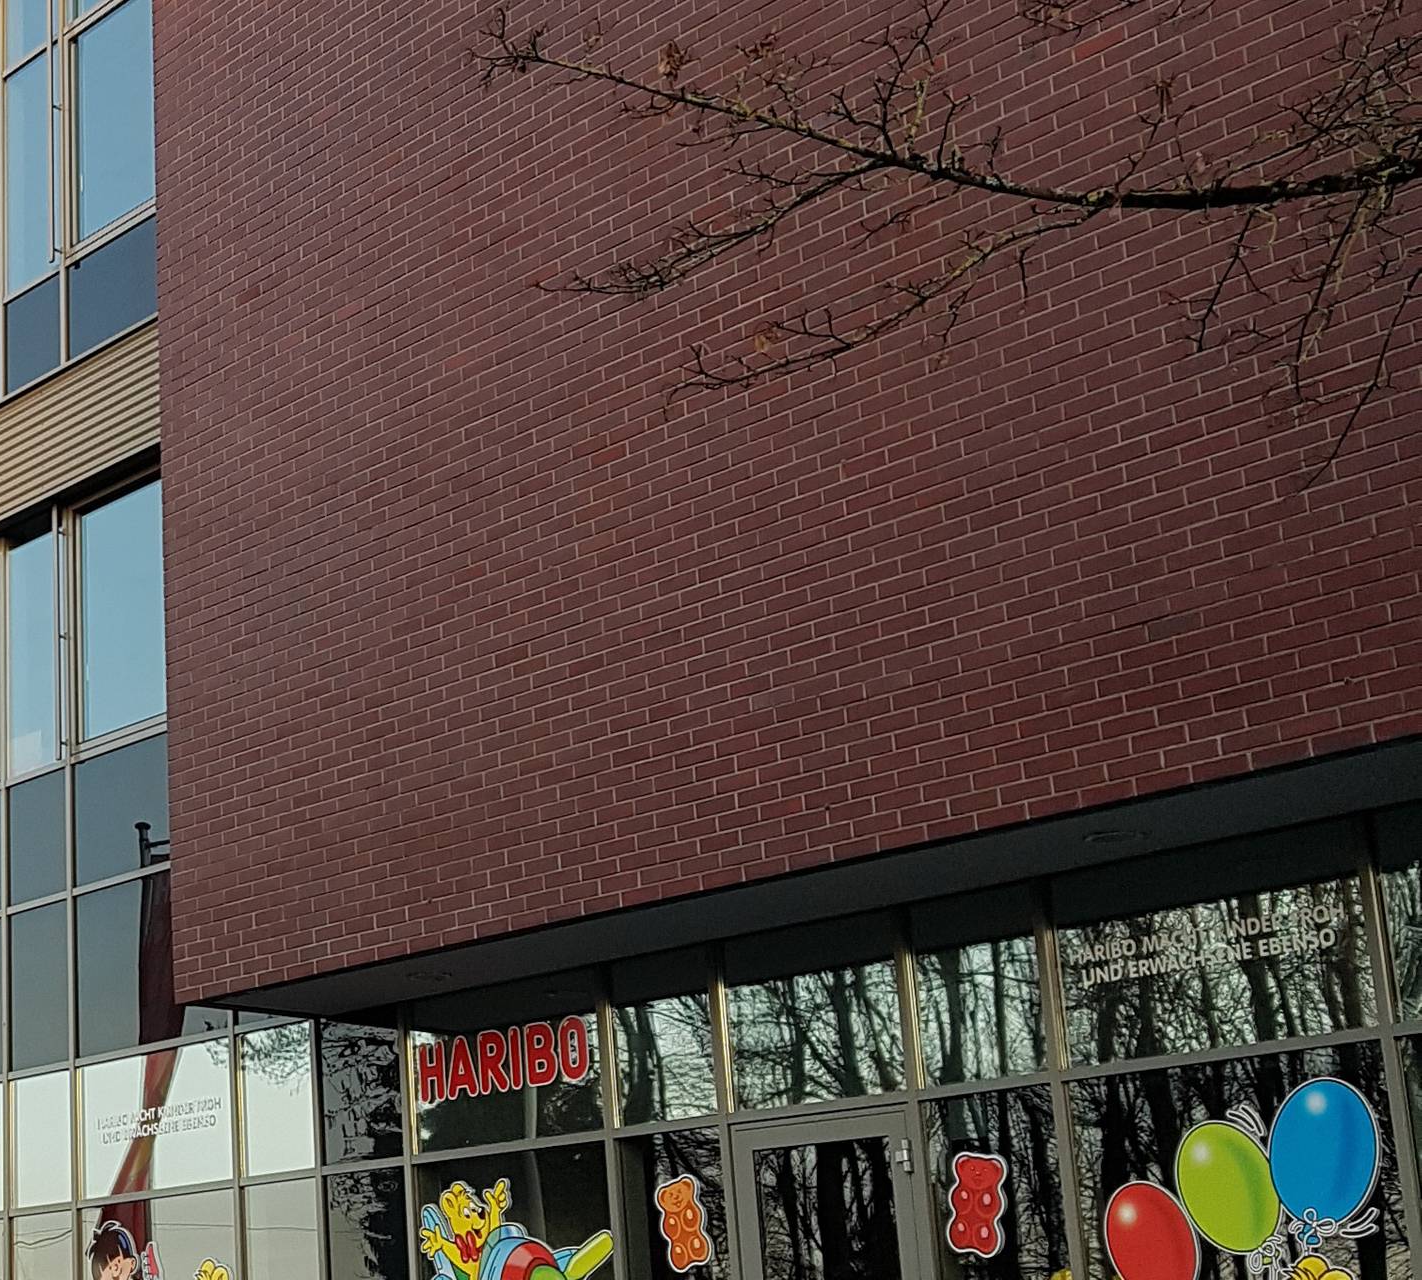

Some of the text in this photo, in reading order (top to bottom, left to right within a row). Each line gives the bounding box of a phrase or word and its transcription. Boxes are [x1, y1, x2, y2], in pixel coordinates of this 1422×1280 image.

[1069, 938, 1137, 966] HARIBO
[1082, 963, 1124, 988] UND
[1258, 928, 1336, 957] EBENSO
[418, 1015, 589, 1104] HARIBO
